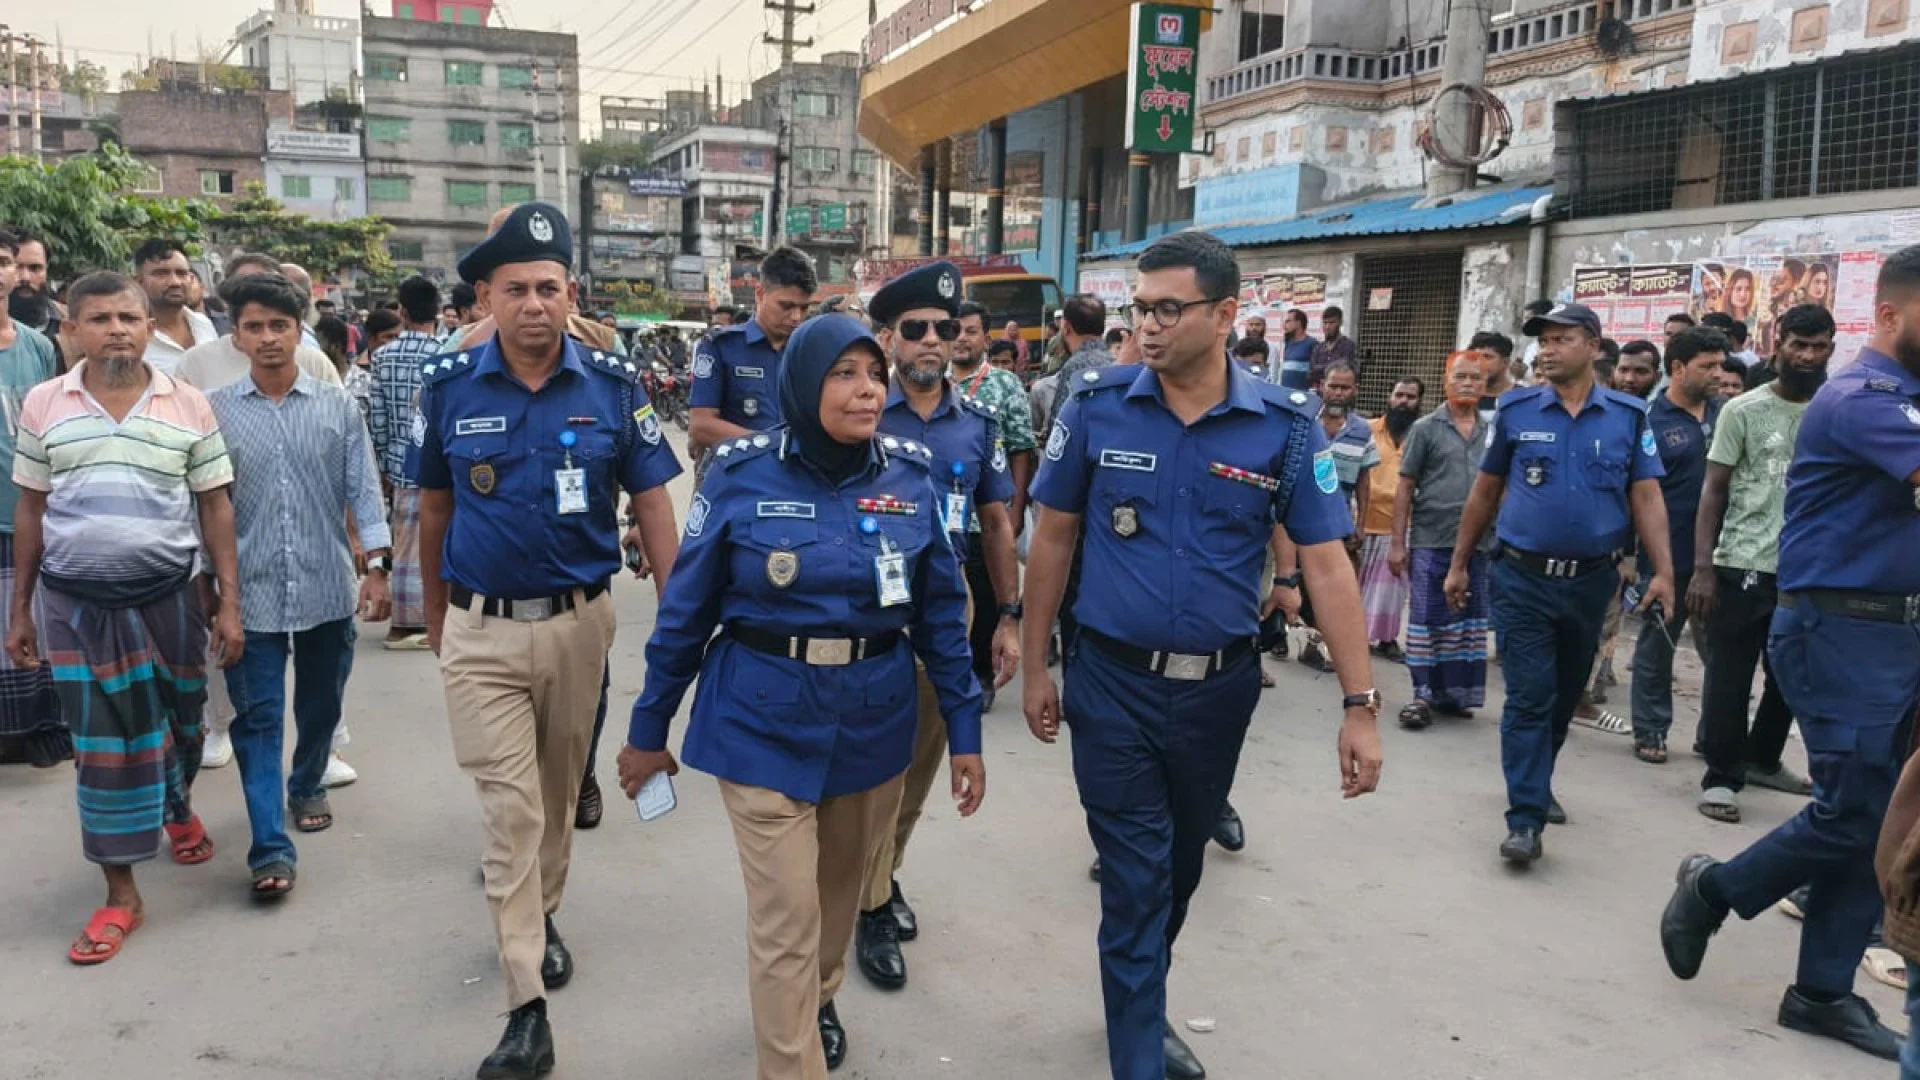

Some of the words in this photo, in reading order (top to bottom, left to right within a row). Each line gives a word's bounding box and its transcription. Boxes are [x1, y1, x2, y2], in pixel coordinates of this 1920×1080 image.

[1143, 45, 1194, 79] ফুয়েল
[1140, 85, 1191, 116] স্টেশন
[1632, 271, 1678, 291] ক্যাডেট
